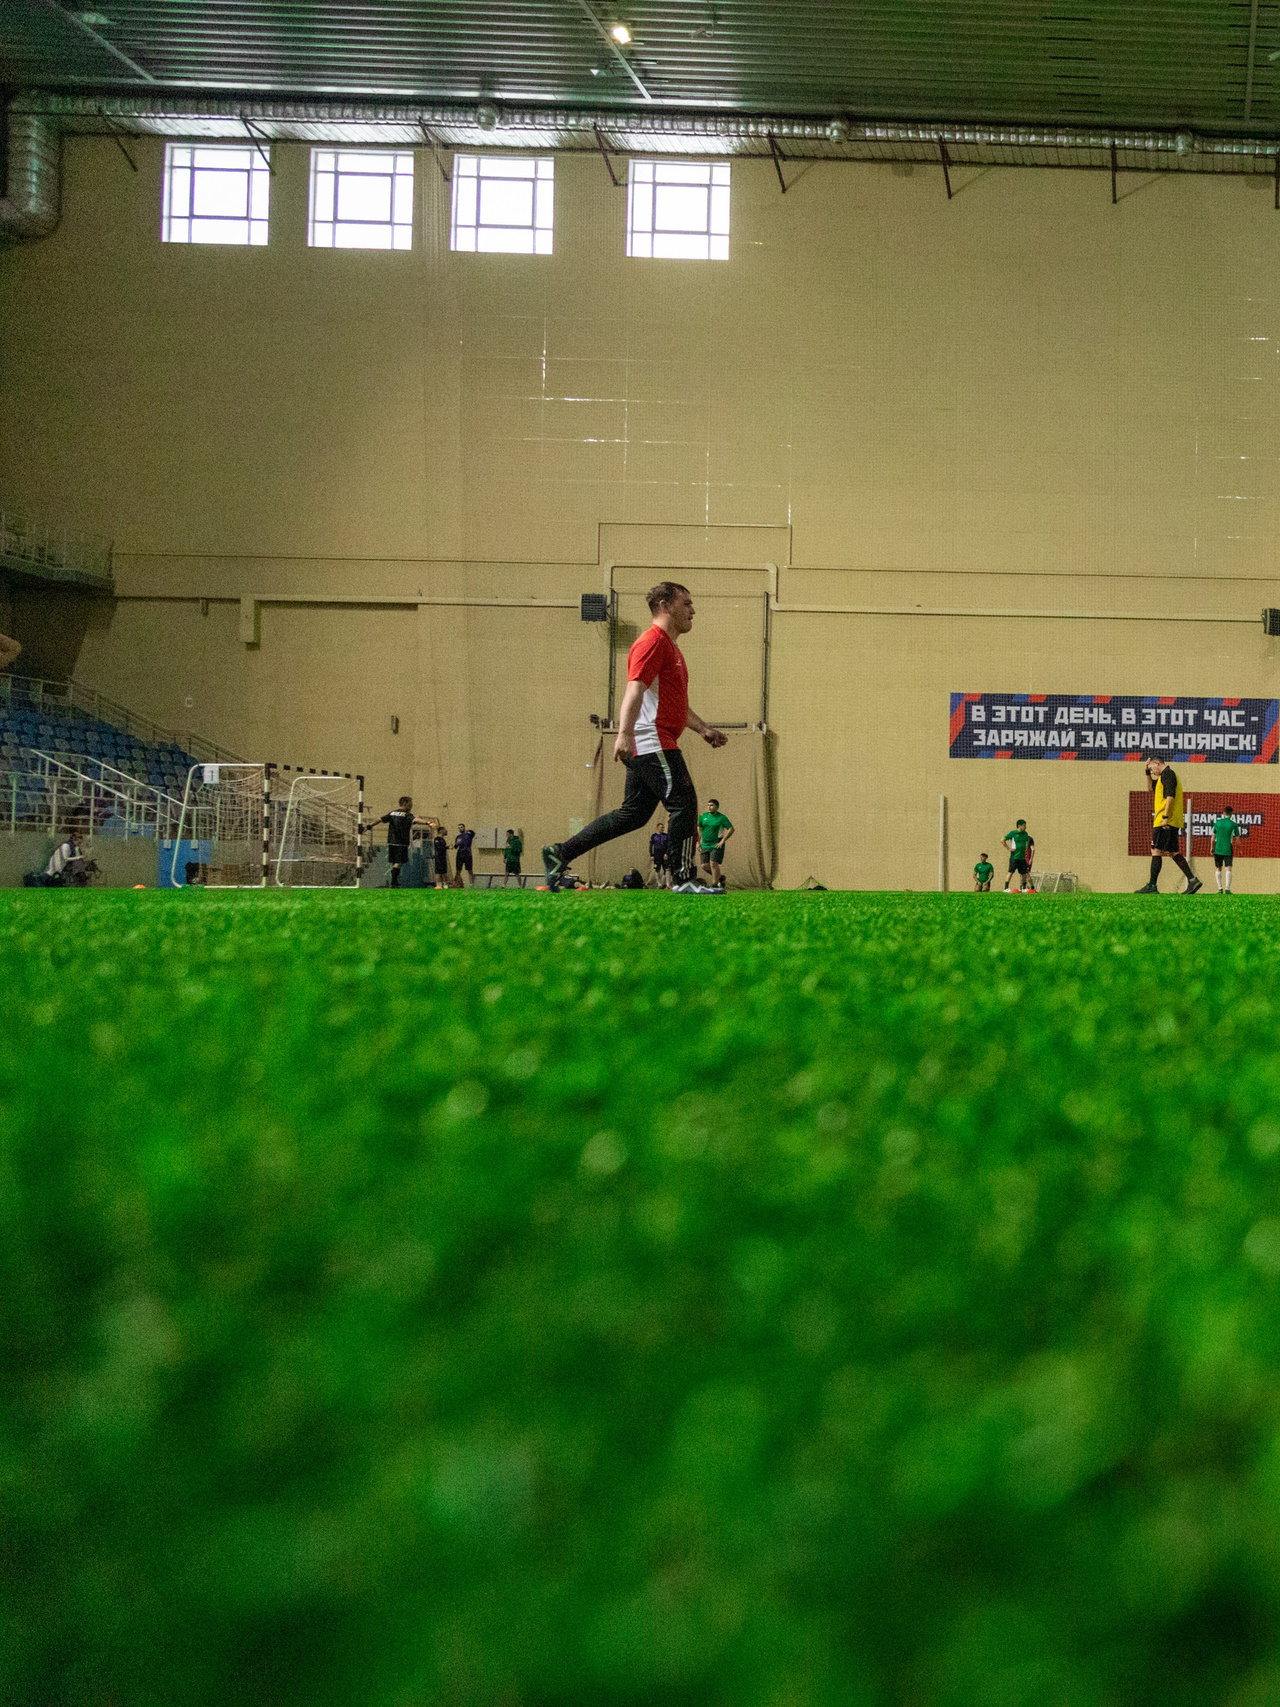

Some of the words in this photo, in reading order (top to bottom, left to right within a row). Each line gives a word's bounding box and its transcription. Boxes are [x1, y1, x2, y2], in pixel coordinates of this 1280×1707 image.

[971, 705, 986, 722] В
[991, 705, 1049, 723] ЭТОТ
[1054, 706, 1117, 726] ДЕНЬ,
[1121, 707, 1137, 725] В
[1141, 708, 1199, 726] ЭТОТ
[1203, 710, 1246, 727] ЧАС
[972, 728, 1076, 747] ЗАРЯЖАЙ
[1080, 731, 1108, 748] ЗА
[1113, 732, 1257, 751] КРАСНОЯРСК!
